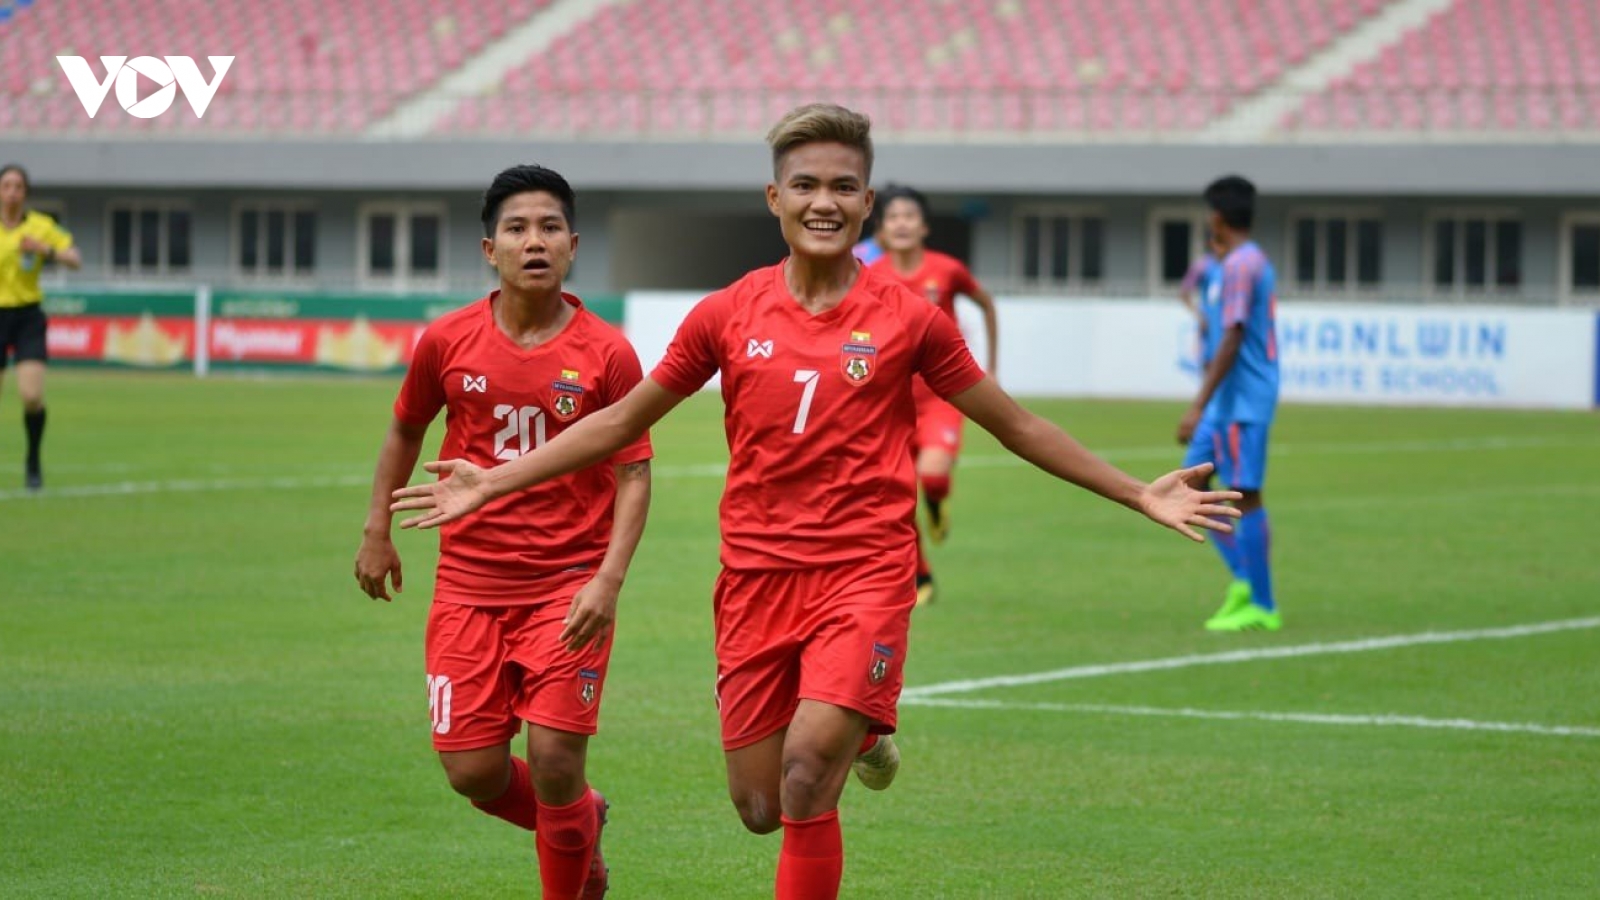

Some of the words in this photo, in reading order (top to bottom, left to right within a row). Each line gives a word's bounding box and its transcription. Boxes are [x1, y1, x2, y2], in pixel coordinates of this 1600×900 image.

[1281, 320, 1507, 358] HANLWIN
[793, 370, 820, 433] 7
[493, 403, 546, 460] 20
